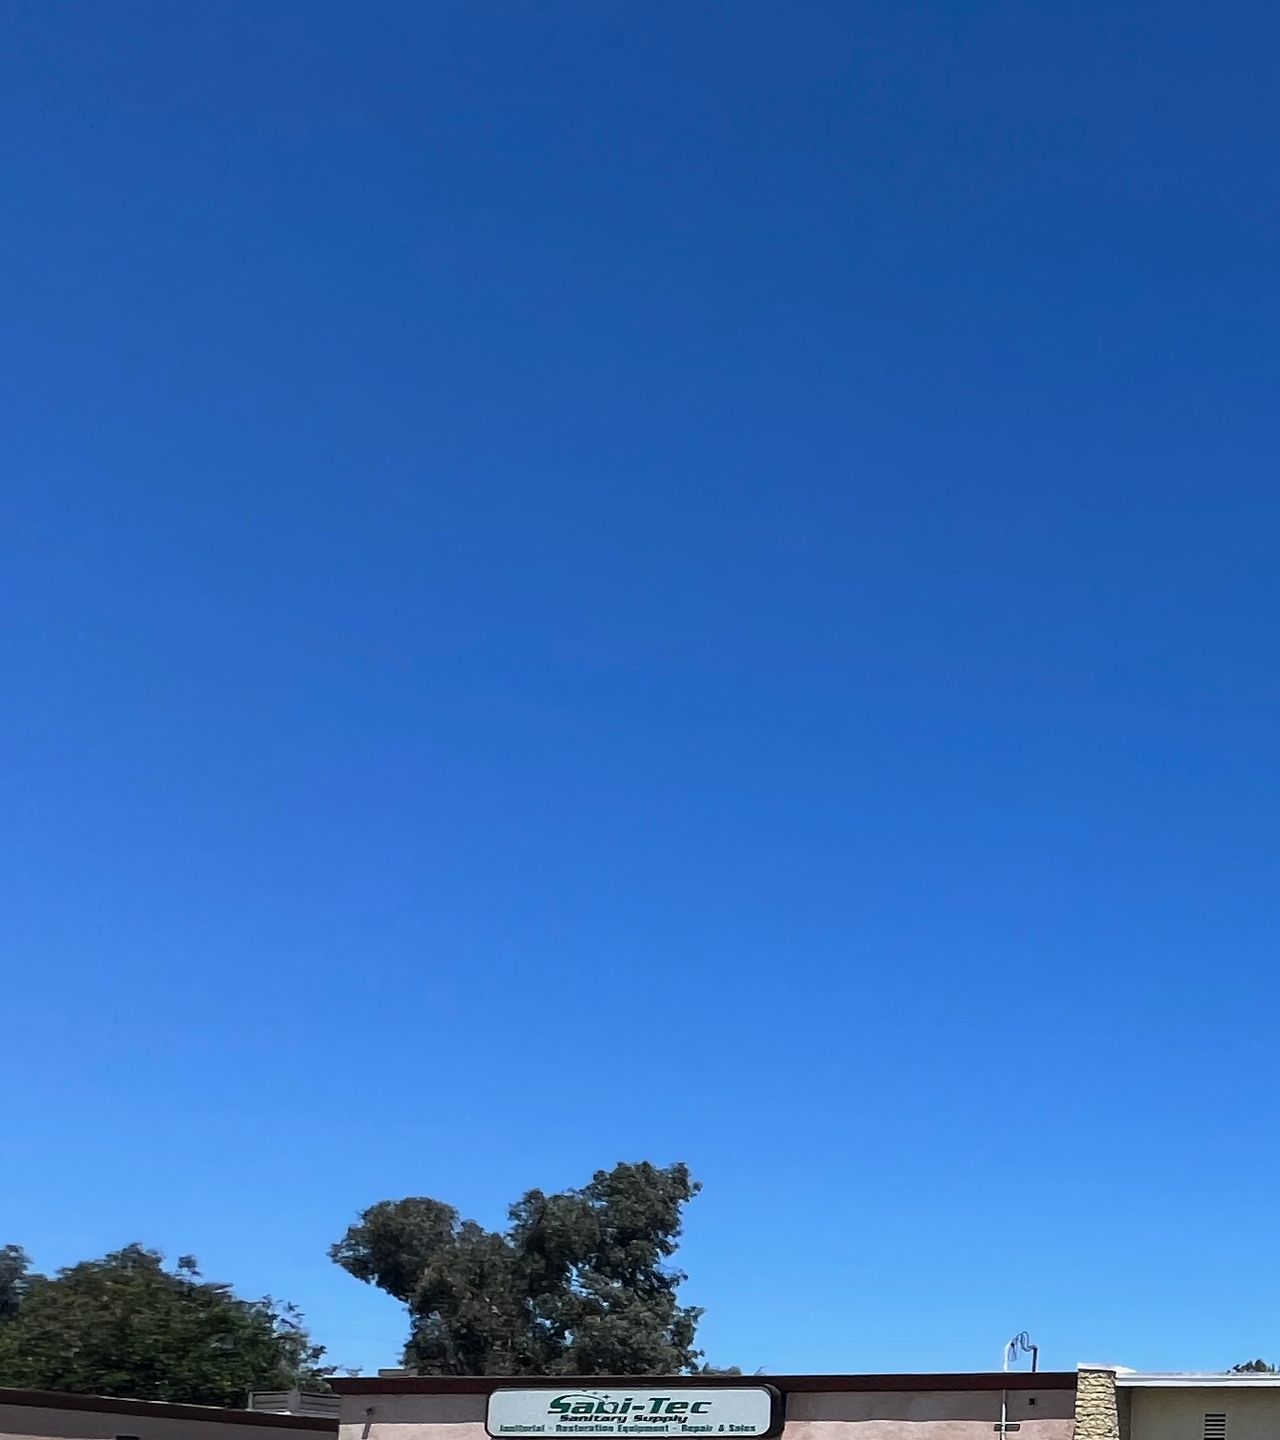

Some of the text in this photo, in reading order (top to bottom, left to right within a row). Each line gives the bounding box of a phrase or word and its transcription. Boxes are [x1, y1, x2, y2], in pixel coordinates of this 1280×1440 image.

[560, 1414, 688, 1423] Sanitary Supply
[617, 1425, 669, 1433] Equipment
[682, 1425, 713, 1433] Repair
